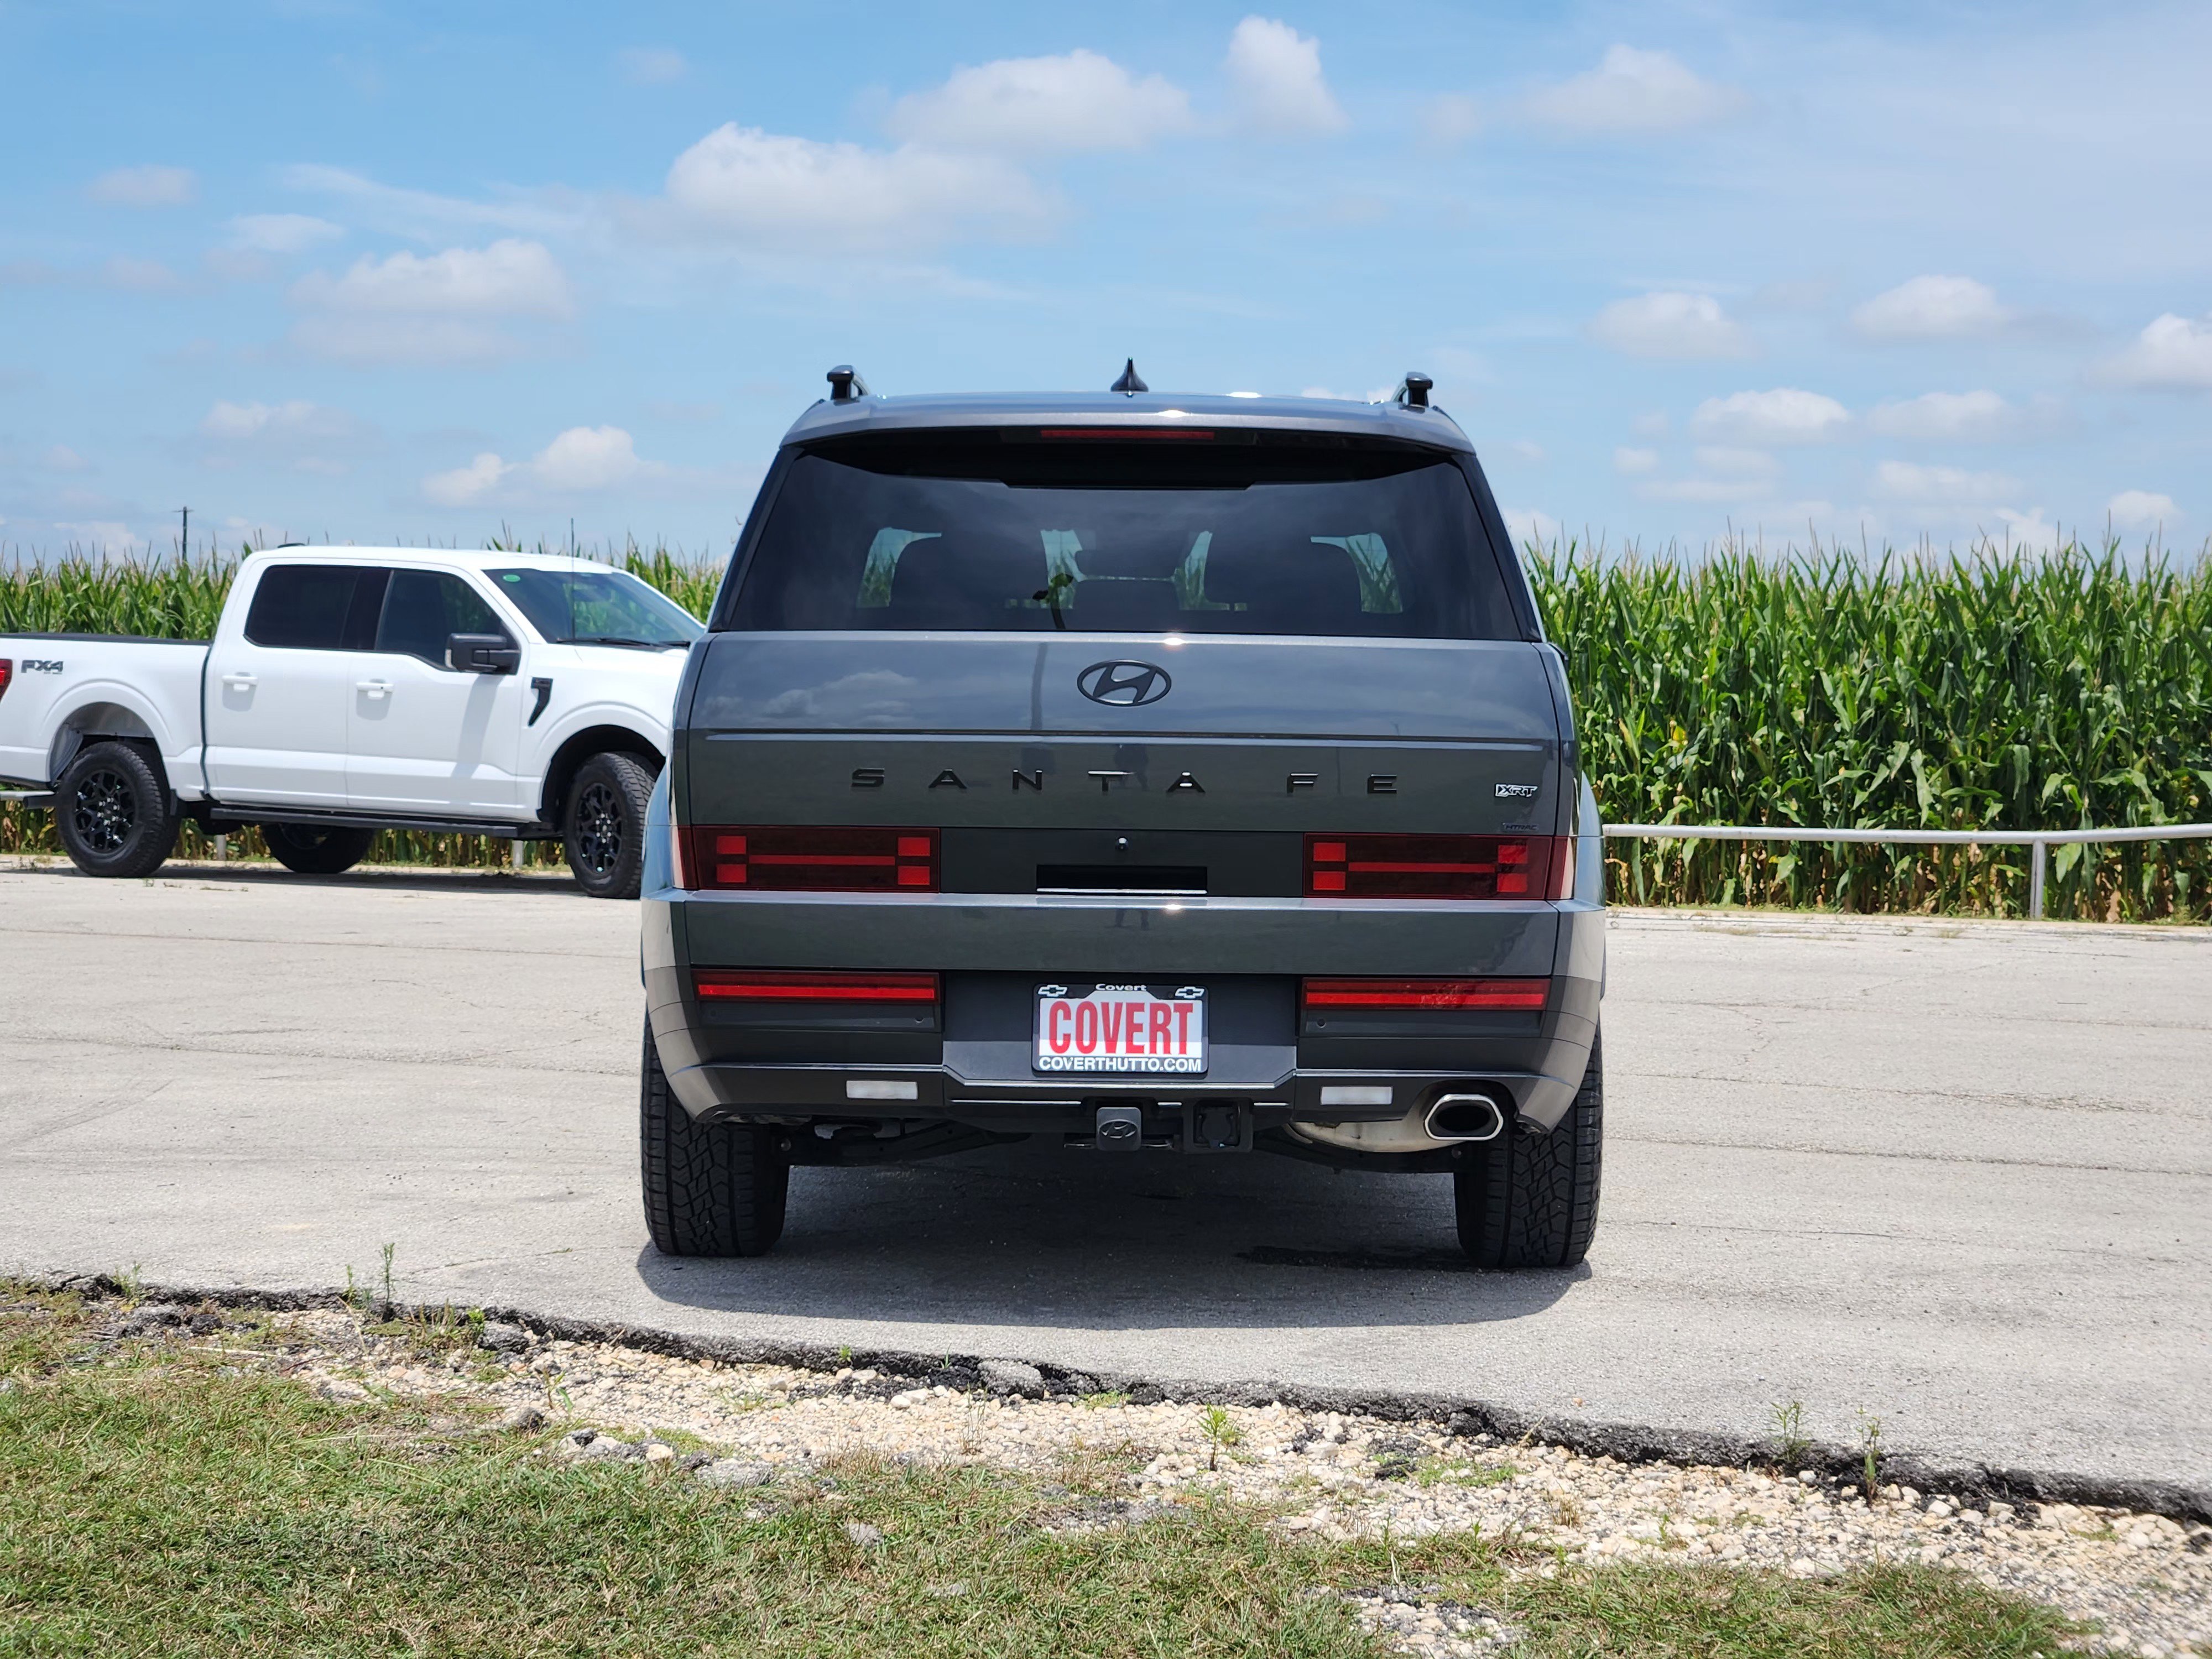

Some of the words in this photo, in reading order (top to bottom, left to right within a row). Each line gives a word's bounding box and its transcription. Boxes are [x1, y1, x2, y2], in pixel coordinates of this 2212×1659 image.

[21, 659, 64, 673] FX4
[851, 768, 1206, 793] SANTA
[1286, 773, 1397, 794] FE
[1495, 784, 1538, 797] XRT
[1049, 1001, 1193, 1055] COVERT
[1039, 1057, 1202, 1072] COVERTHUTTO.COM
